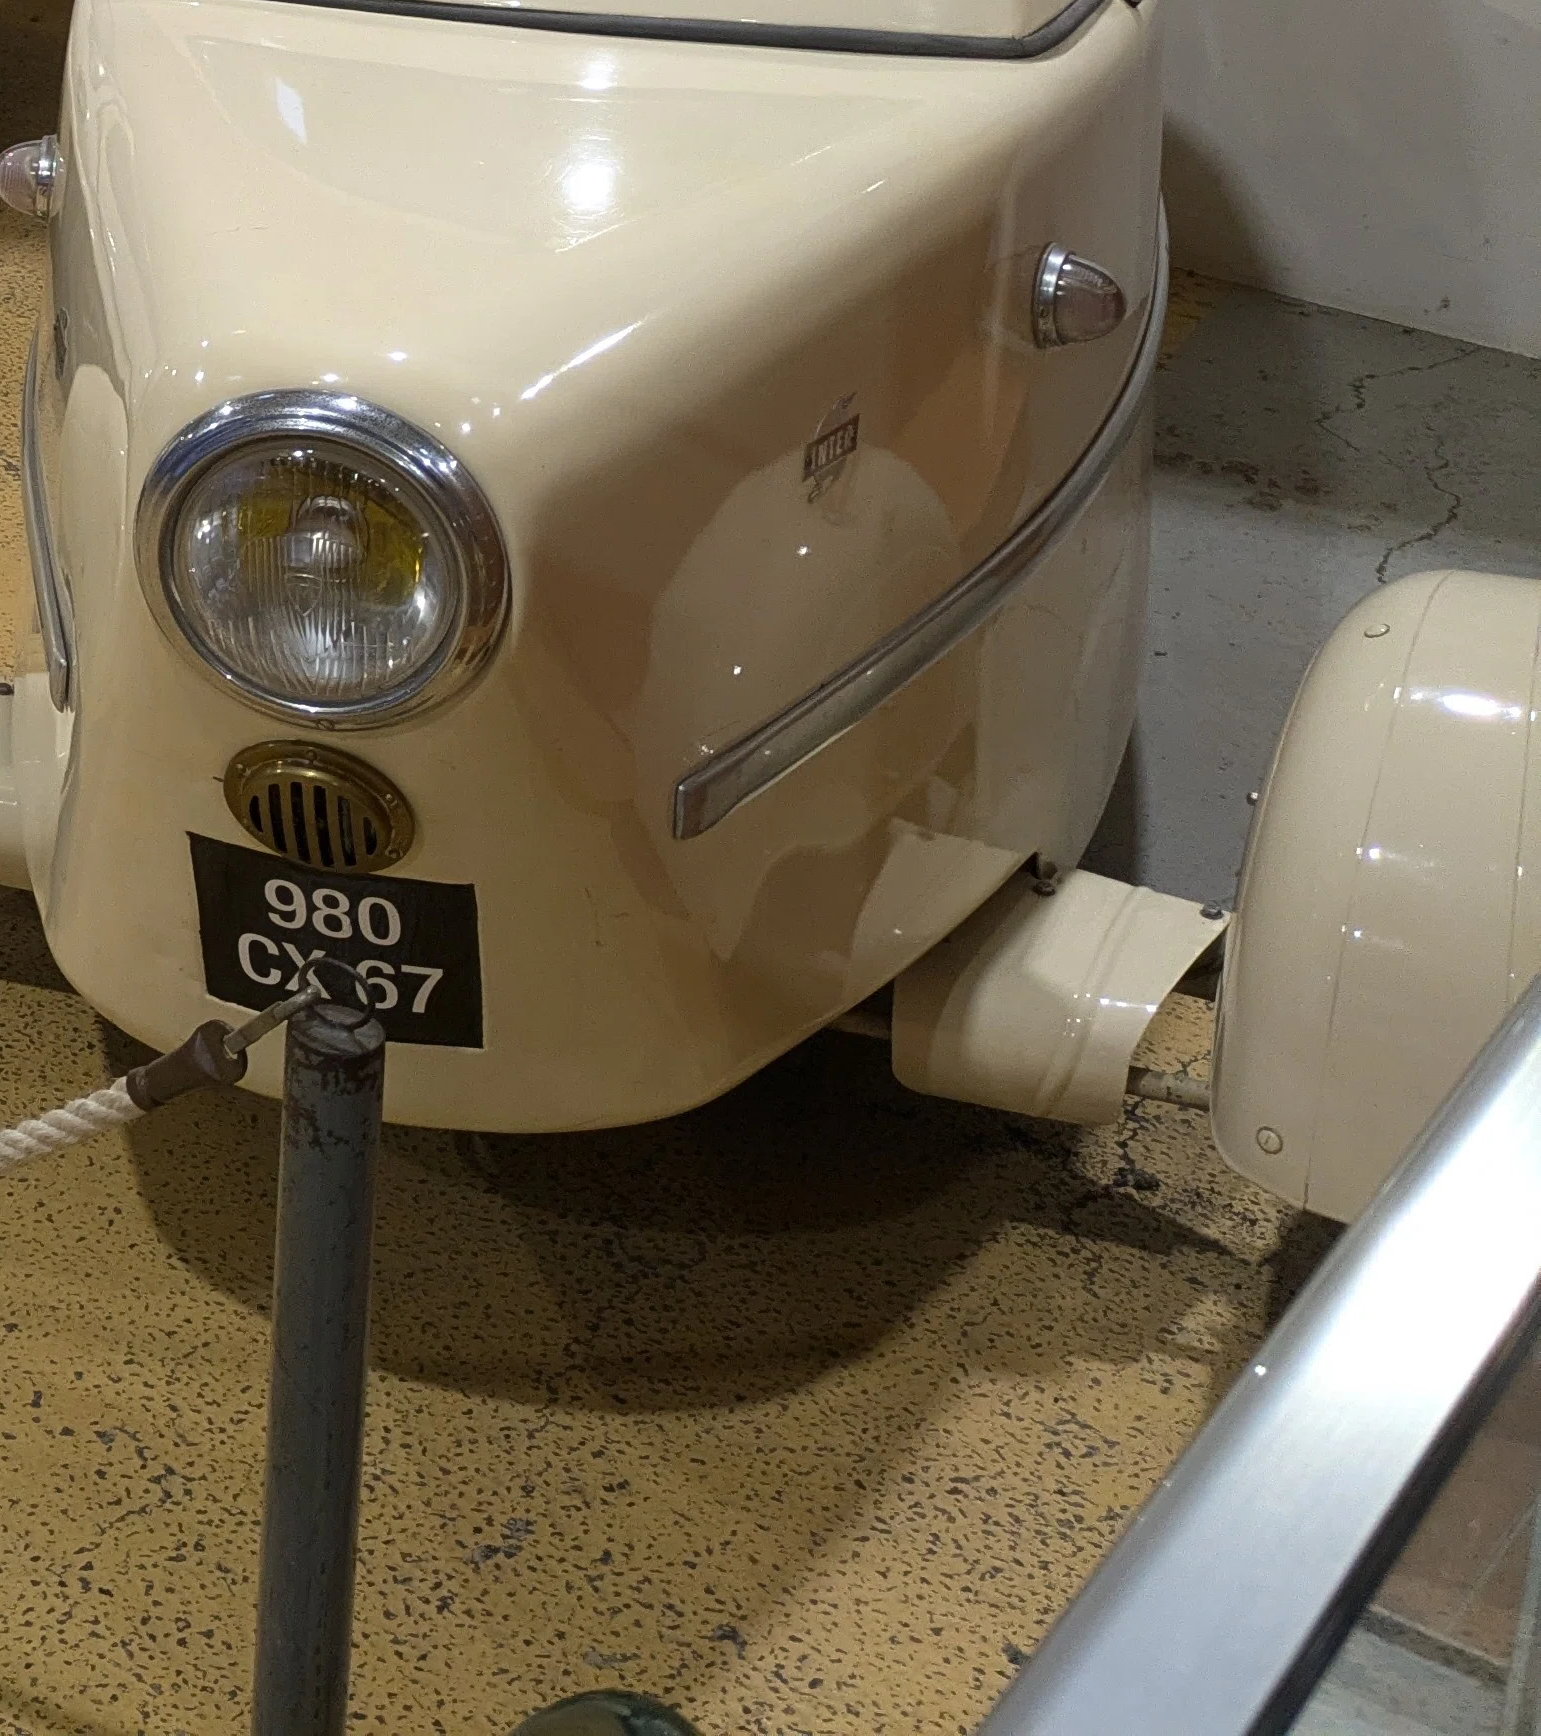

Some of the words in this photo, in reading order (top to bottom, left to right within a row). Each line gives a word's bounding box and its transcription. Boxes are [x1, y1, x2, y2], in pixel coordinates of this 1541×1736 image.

[264, 878, 401, 946] 980
[237, 933, 331, 1000] CX
[354, 959, 444, 1014] 67
